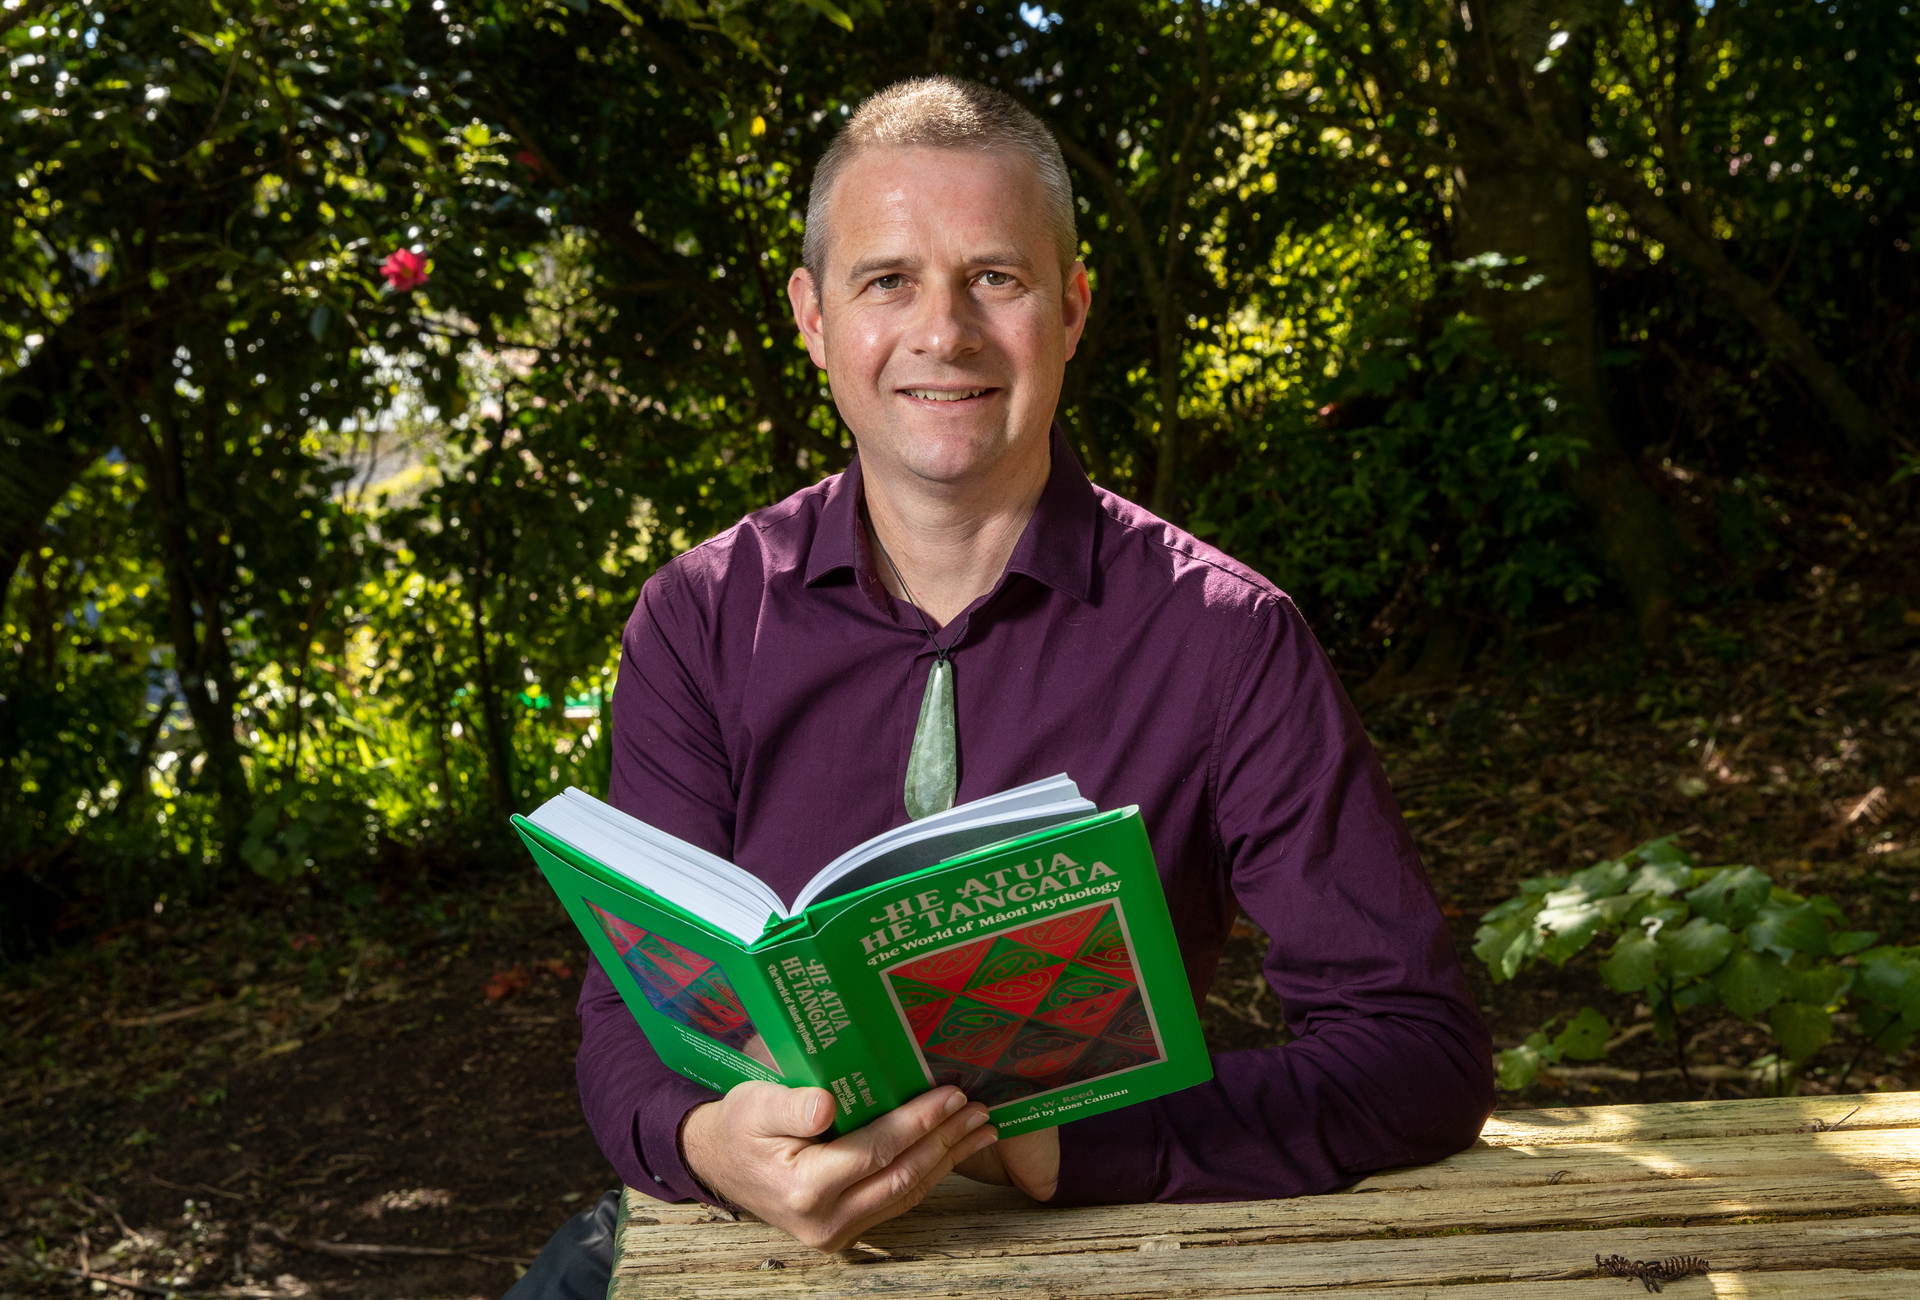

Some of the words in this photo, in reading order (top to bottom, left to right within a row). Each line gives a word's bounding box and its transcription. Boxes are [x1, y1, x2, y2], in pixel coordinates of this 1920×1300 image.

[859, 919, 917, 955] HE
[918, 861, 1118, 929] TANGATA
[870, 889, 944, 923] HE
[956, 852, 1079, 899] ATUA
[867, 947, 900, 967] The
[901, 928, 953, 951] World
[955, 921, 975, 934] of
[1031, 880, 1122, 912] Mythology
[780, 955, 806, 980] HE
[805, 958, 832, 987] HE
[767, 964, 779, 978] The
[774, 976, 790, 997] World
[783, 996, 795, 1004] of
[796, 1022, 818, 1054] Mythology
[792, 977, 838, 1050] TANGATA
[818, 989, 851, 1032] ATUA
[830, 1080, 842, 1094] Ross
[837, 1093, 853, 1115] Calman
[839, 1076, 855, 1099] Revised
[849, 1096, 857, 1106] by
[860, 1087, 877, 1107] Reed
[998, 1112, 1041, 1129] Revised
[1041, 1108, 1056, 1117] by
[1057, 1101, 1083, 1112] Ross
[1084, 1088, 1129, 1105] Calman
[1062, 1089, 1095, 1104] Reed
